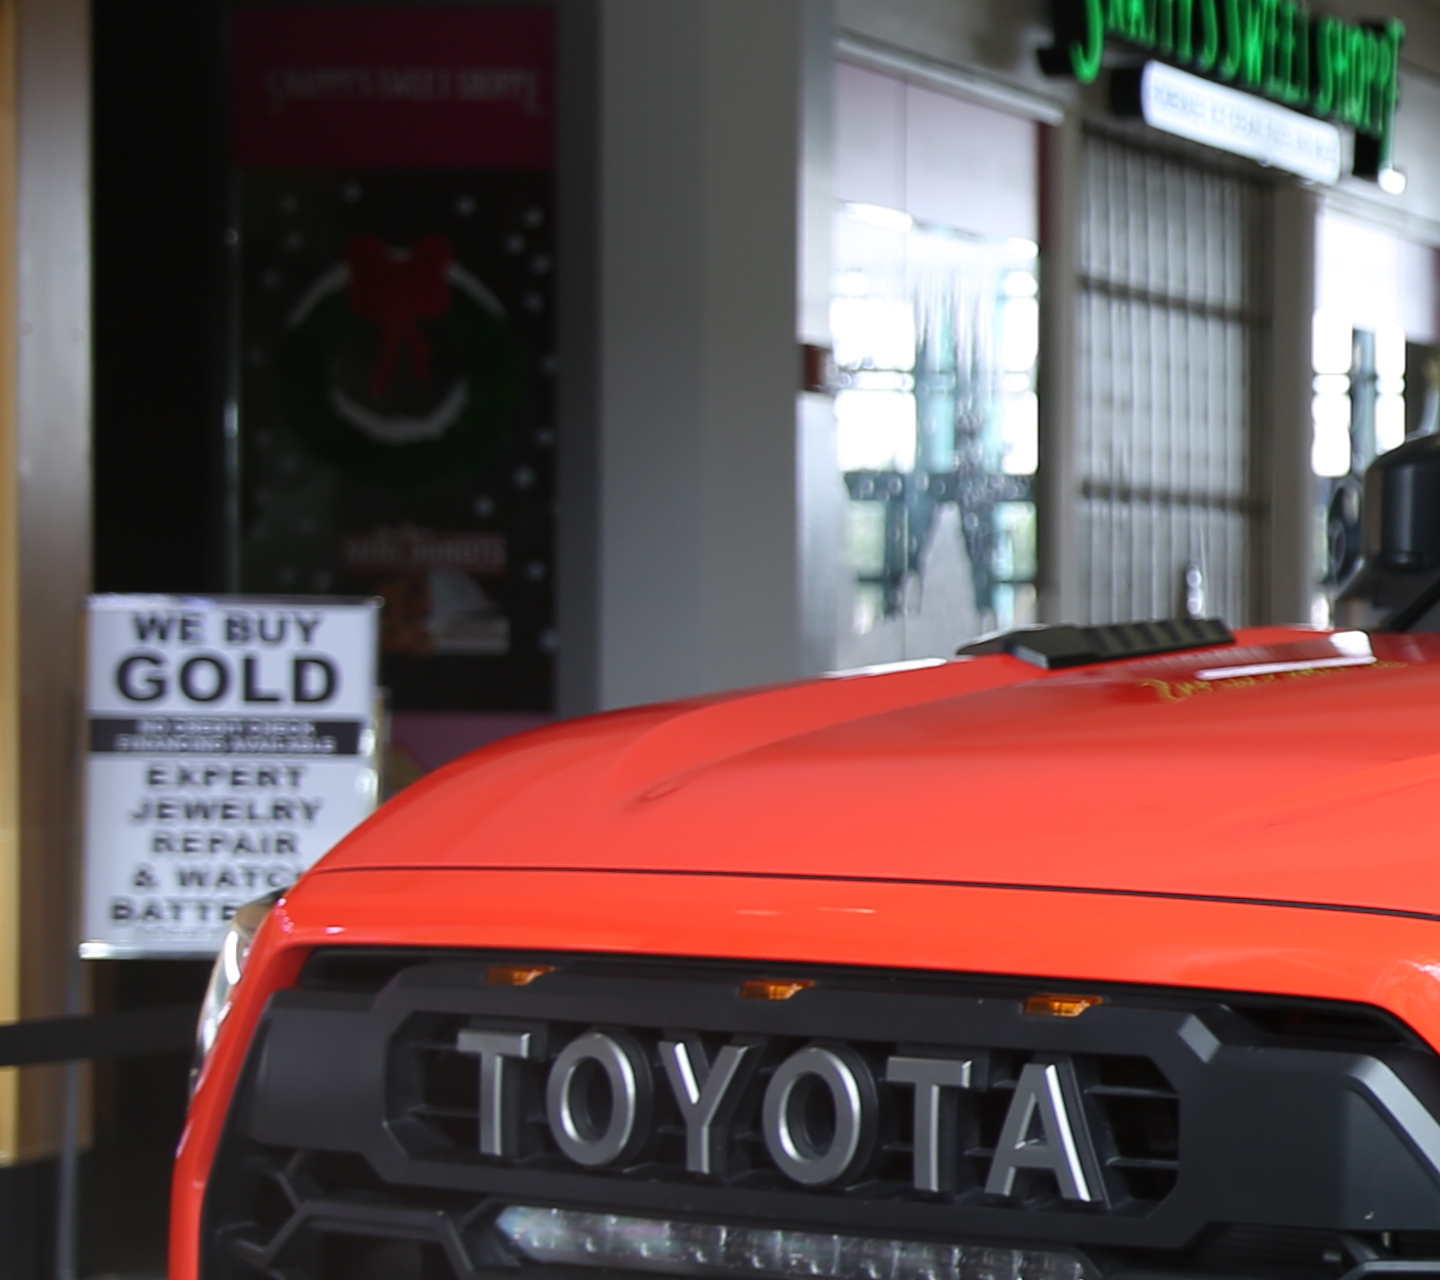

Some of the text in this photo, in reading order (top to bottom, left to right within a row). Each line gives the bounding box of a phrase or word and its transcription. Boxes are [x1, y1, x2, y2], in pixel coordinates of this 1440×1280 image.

[133, 611, 321, 642] WE BUY
[115, 654, 339, 704] GOLD
[146, 766, 306, 788] EXPERT
[129, 800, 322, 822] JEWELRY
[151, 833, 298, 854] REPAIR
[110, 900, 238, 922] BATTE
[455, 1027, 1108, 1206] TOYOTA
